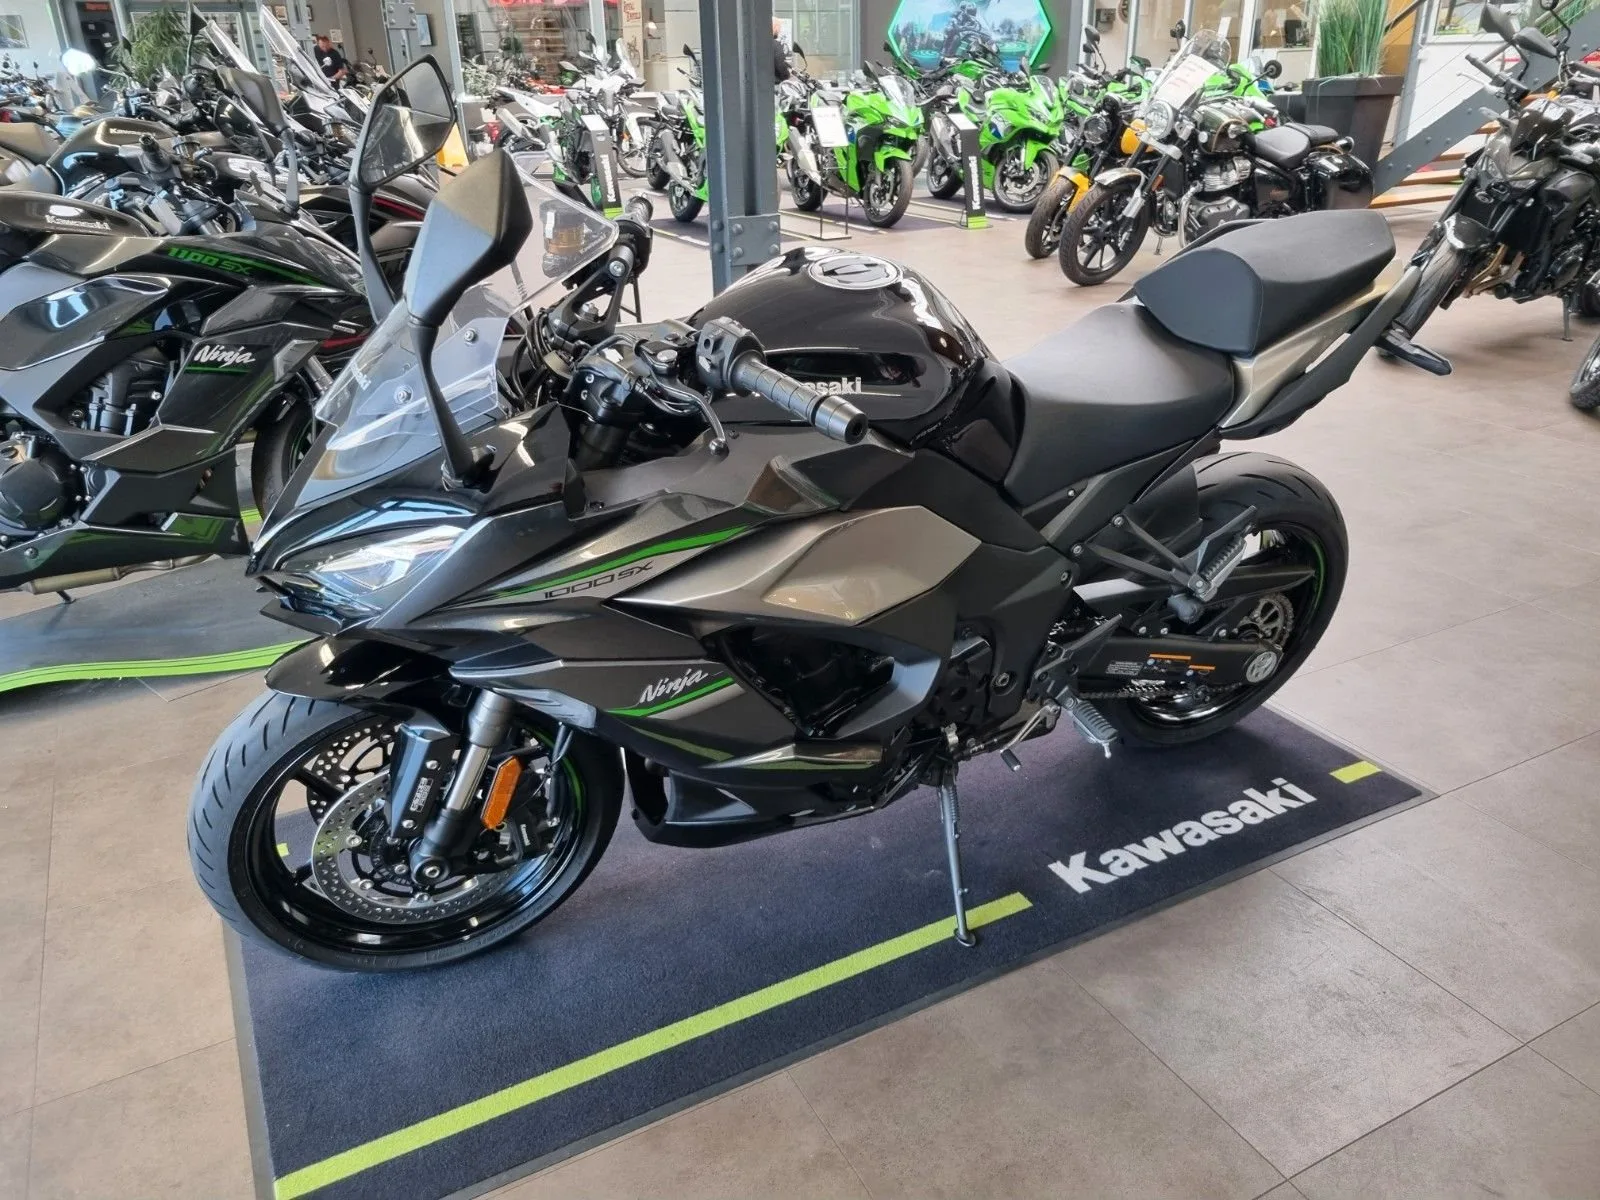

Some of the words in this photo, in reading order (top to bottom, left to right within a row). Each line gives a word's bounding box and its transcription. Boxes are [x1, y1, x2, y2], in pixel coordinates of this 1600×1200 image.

[168, 247, 219, 266] 1100
[218, 260, 252, 276] SX
[194, 344, 256, 369] Ninja
[544, 573, 615, 599] 1000
[617, 560, 655, 581] SX
[640, 668, 709, 703] Ninja
[1047, 777, 1317, 894] Kawasaki
